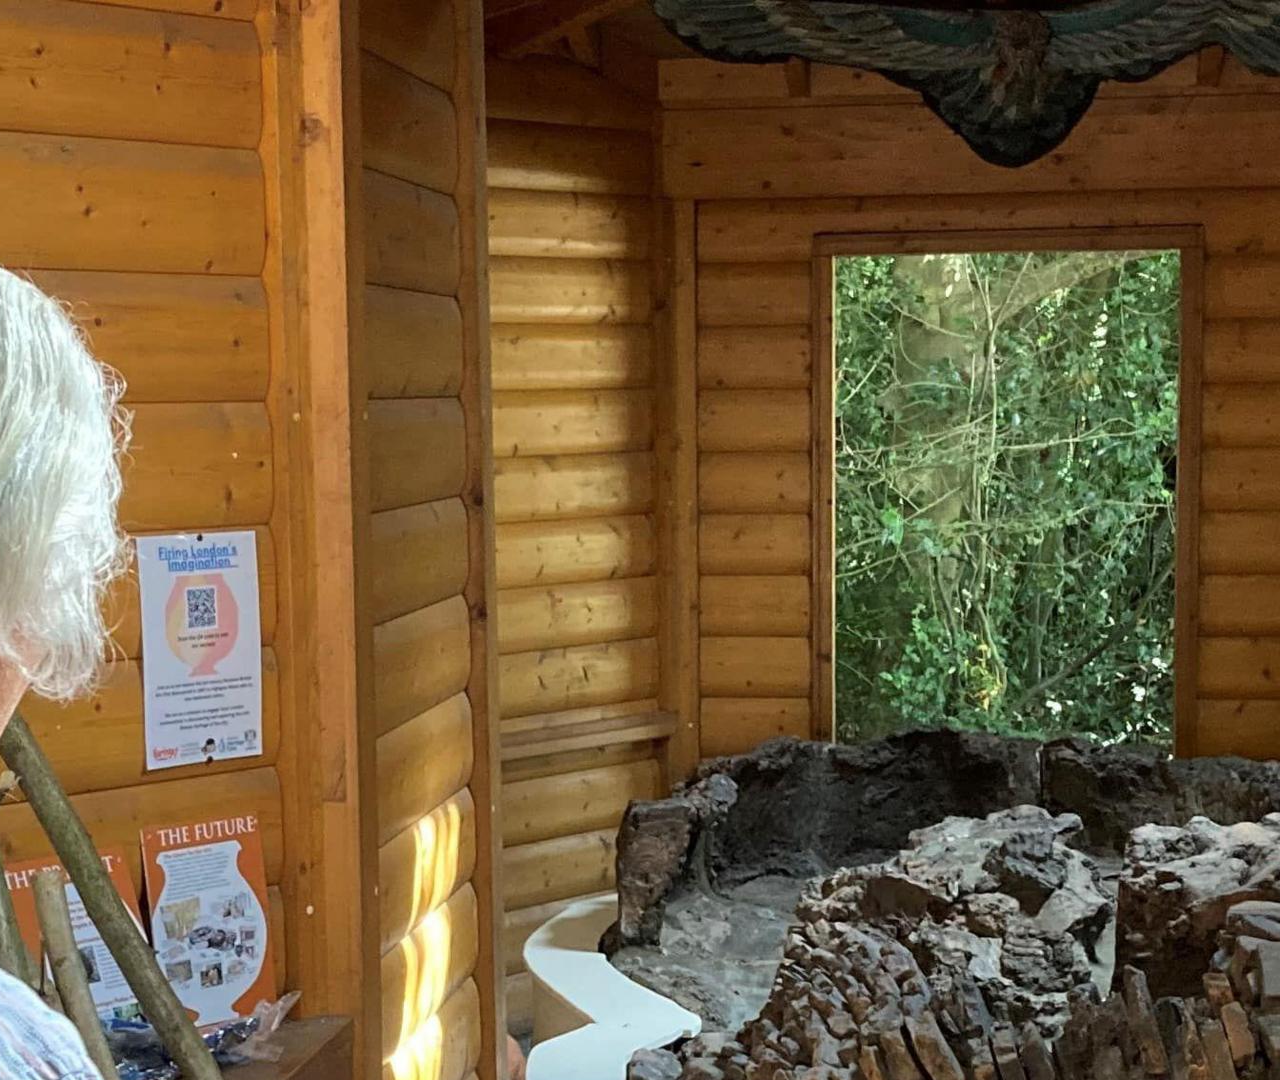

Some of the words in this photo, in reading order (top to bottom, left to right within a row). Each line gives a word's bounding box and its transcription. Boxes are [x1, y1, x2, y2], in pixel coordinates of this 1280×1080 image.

[159, 546, 188, 560] Firing
[191, 543, 236, 559] London's
[168, 556, 231, 571] Imagination
[157, 826, 191, 846] THE
[195, 815, 256, 841] FUTURE
